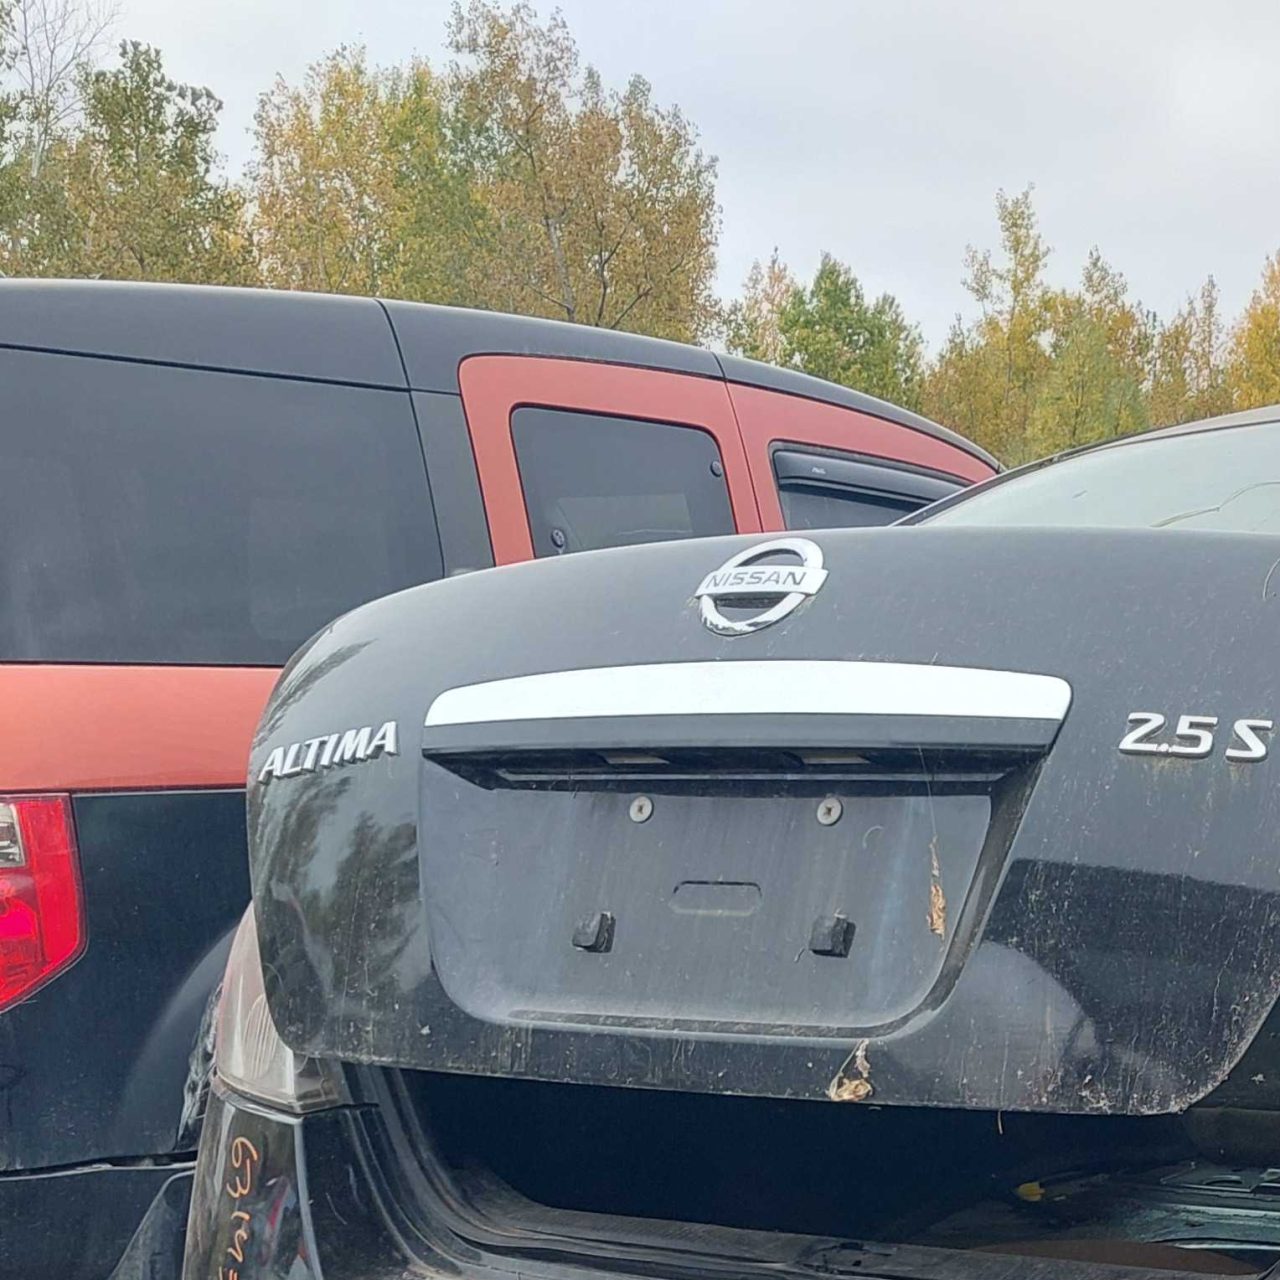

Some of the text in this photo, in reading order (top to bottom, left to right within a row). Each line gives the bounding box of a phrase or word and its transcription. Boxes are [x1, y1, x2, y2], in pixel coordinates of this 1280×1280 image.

[705, 570, 807, 590] NISSAN
[257, 720, 399, 785] ALTIMA
[1118, 711, 1274, 763] 2.5 S
